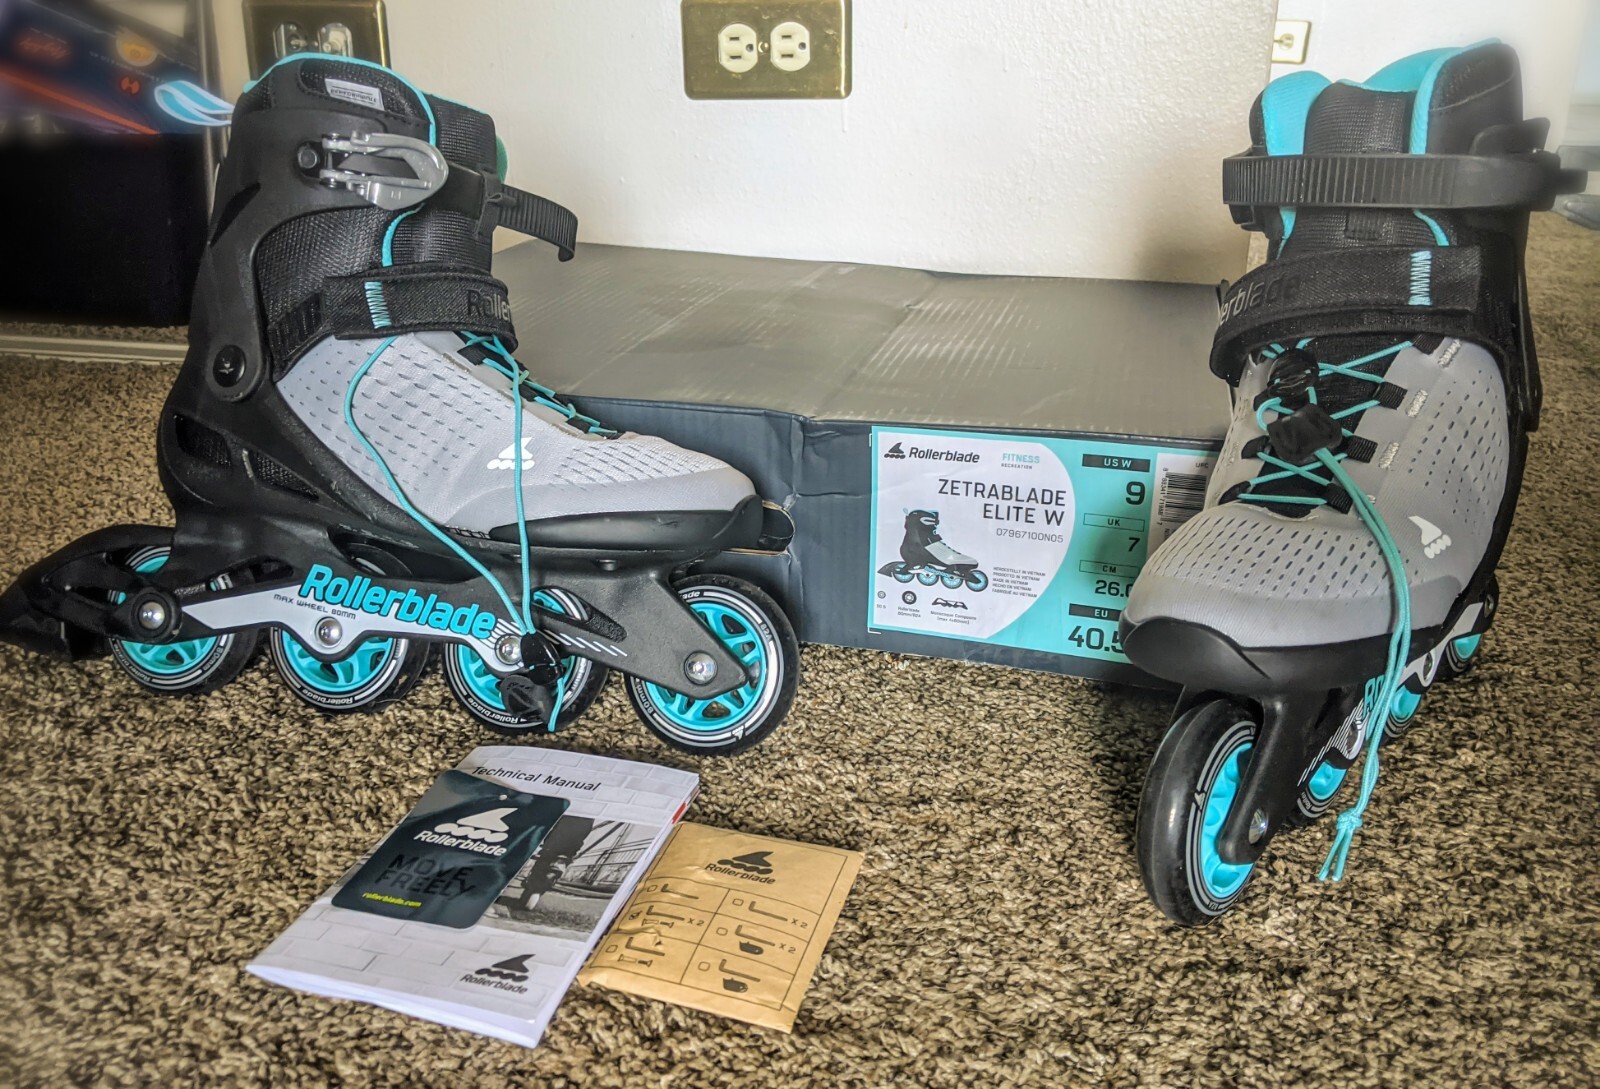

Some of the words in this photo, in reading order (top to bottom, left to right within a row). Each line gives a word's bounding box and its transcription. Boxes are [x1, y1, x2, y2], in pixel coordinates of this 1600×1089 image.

[908, 447, 980, 464] Rollerblade
[1002, 452, 1040, 464] FITNESS
[1104, 458, 1119, 467] US
[1121, 459, 1132, 468] W
[938, 478, 1067, 507] ZETRABLADE
[1125, 481, 1146, 505] 9
[983, 503, 1036, 524] ELITE
[1044, 509, 1065, 527] W
[1107, 518, 1121, 527] UK
[1128, 537, 1140, 552] 7
[1102, 565, 1117, 574] CM
[297, 600, 329, 613] WHEEL
[299, 563, 498, 639] Rollerblade
[1094, 609, 1109, 618] EU
[1068, 625, 1125, 654] 40.5
[302, 689, 354, 705] Rollerblade
[635, 684, 654, 714] 80mm
[467, 697, 519, 724] Rollerblade
[471, 766, 542, 783] Technical
[542, 775, 602, 792] Manual
[414, 830, 507, 856] Rollerblade
[388, 854, 473, 880] MOVE
[704, 863, 776, 885] Rollerblade
[375, 869, 476, 900] FREELY
[459, 973, 529, 995] Rollerblade
